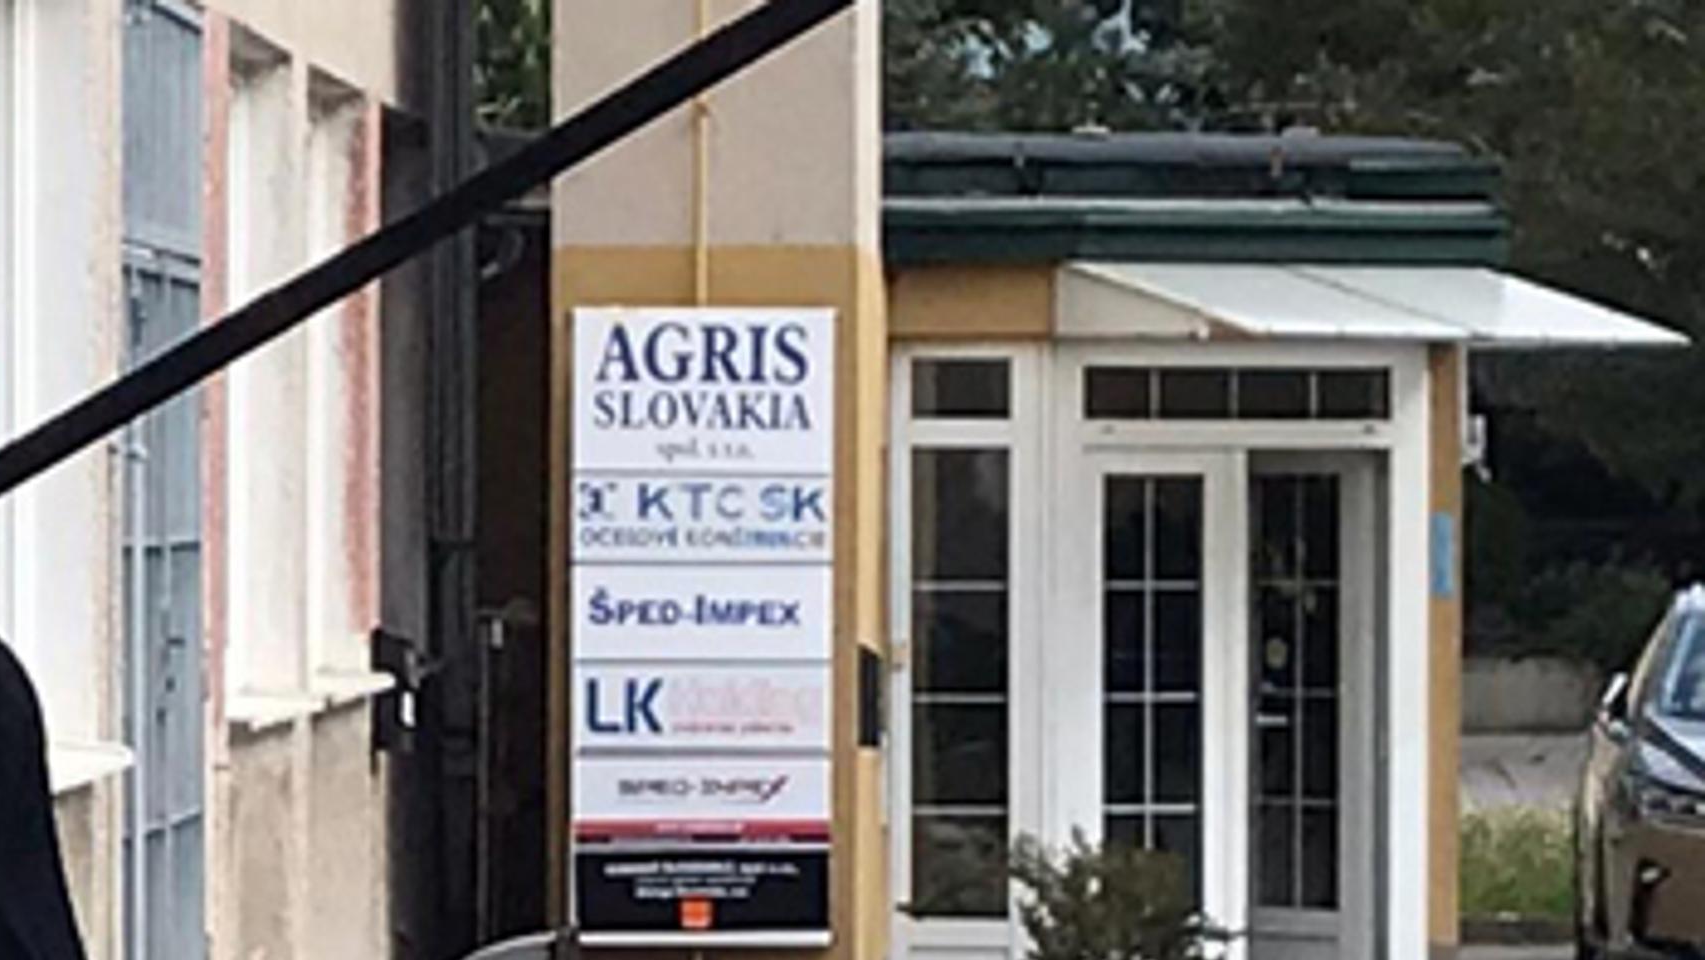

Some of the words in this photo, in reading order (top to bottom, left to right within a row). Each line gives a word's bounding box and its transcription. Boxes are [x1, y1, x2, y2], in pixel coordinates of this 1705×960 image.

[594, 322, 809, 385] AGRIS
[593, 390, 811, 430] SLOVAKIA
[637, 482, 744, 521] KTC
[759, 483, 825, 522] SK
[586, 677, 664, 734] LK
